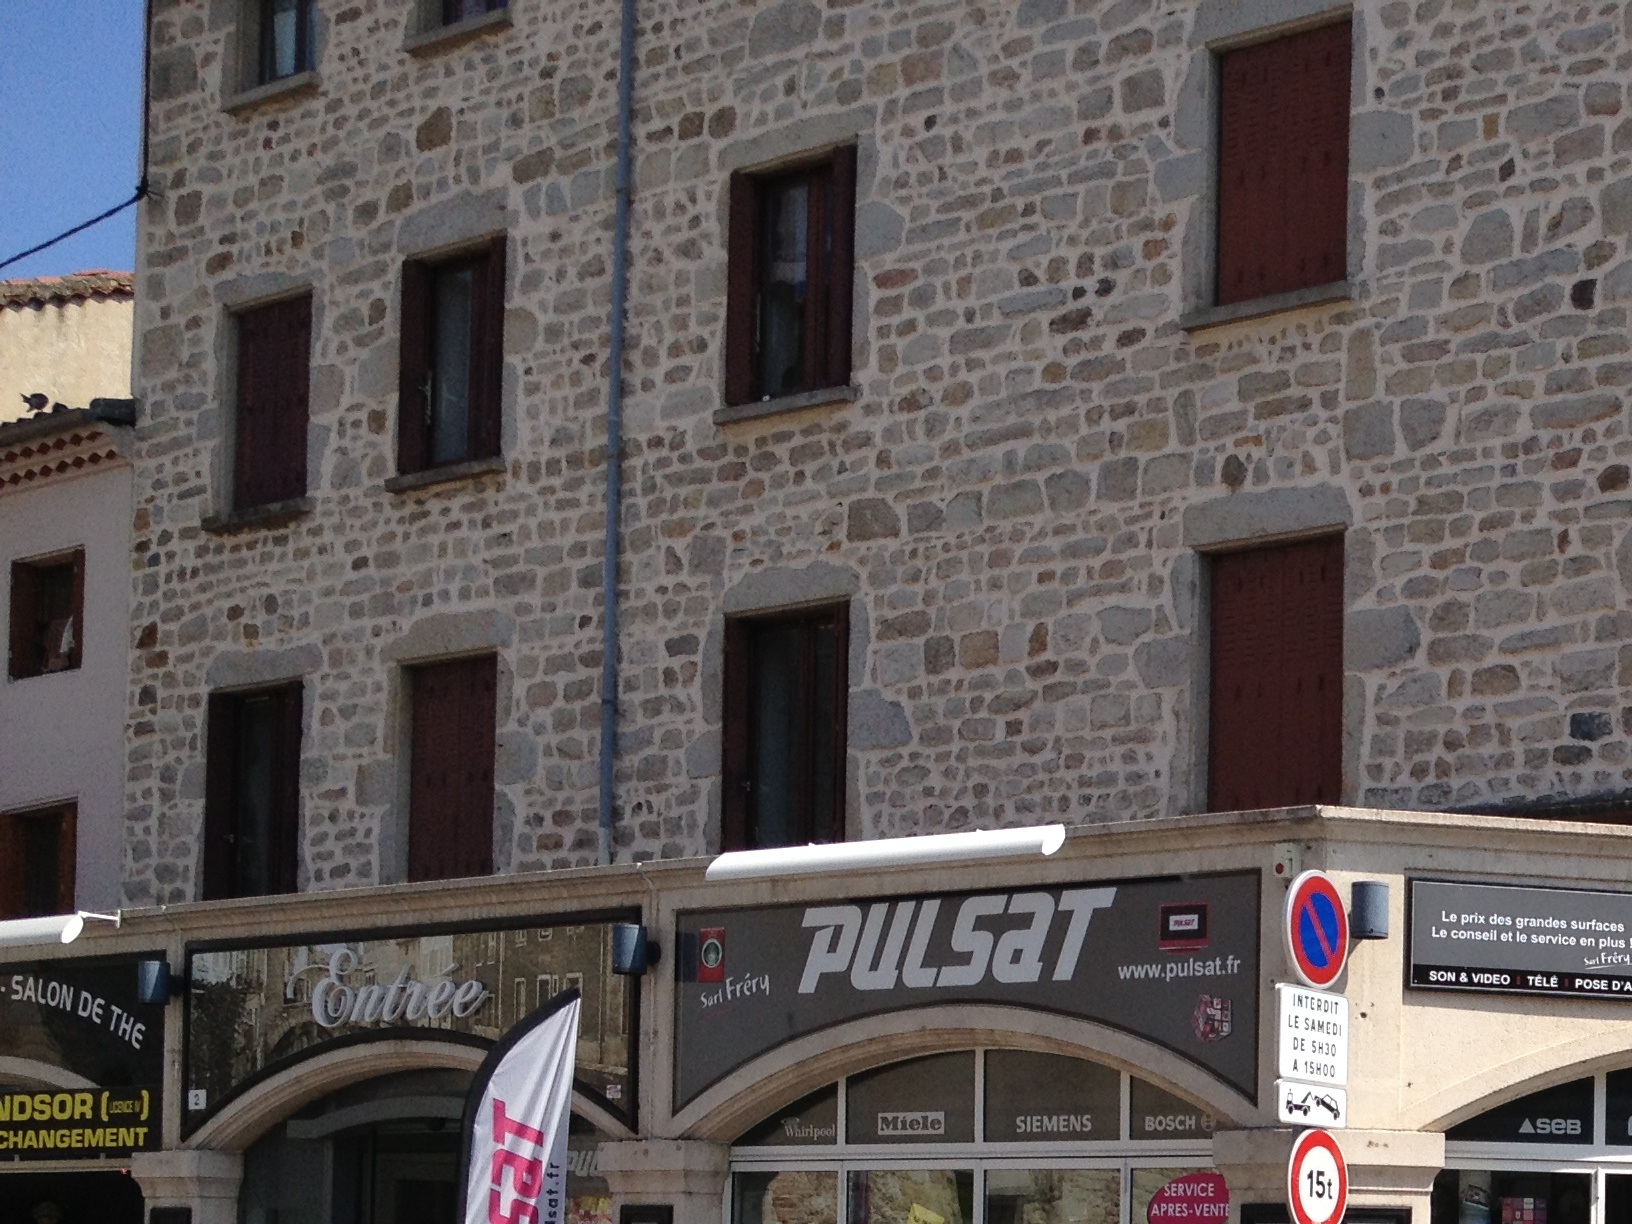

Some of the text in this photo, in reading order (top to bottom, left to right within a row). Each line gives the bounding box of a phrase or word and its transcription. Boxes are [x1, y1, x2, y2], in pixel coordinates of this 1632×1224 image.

[1441, 911, 1625, 932] Le prix des grandes surfaces
[1431, 926, 1627, 949] Le conseil et le service en plus
[1118, 955, 1242, 983] www.pulsat.fr
[1600, 951, 1631, 967] Fréry
[286, 948, 490, 1029] Entrée
[700, 972, 770, 1009] Sarl Fréry
[1429, 971, 1456, 982] SON
[1459, 972, 1469, 982] &
[1472, 973, 1511, 985] VIDEO
[1574, 978, 1609, 991] POSE
[11, 975, 146, 1050] SALON DE THE
[1293, 993, 1339, 1015] INTERDIT
[1288, 1014, 1342, 1036] LE SAMEDI
[1293, 1037, 1337, 1057] DE 5H30
[1292, 1059, 1336, 1078] A 15H00
[784, 1124, 836, 1140] Whirlpool
[879, 1115, 943, 1132] Miele
[1016, 1115, 1093, 1133] SIEMENS
[1144, 1115, 1196, 1131] BOSCH
[1164, 1183, 1215, 1198] SERVICE
